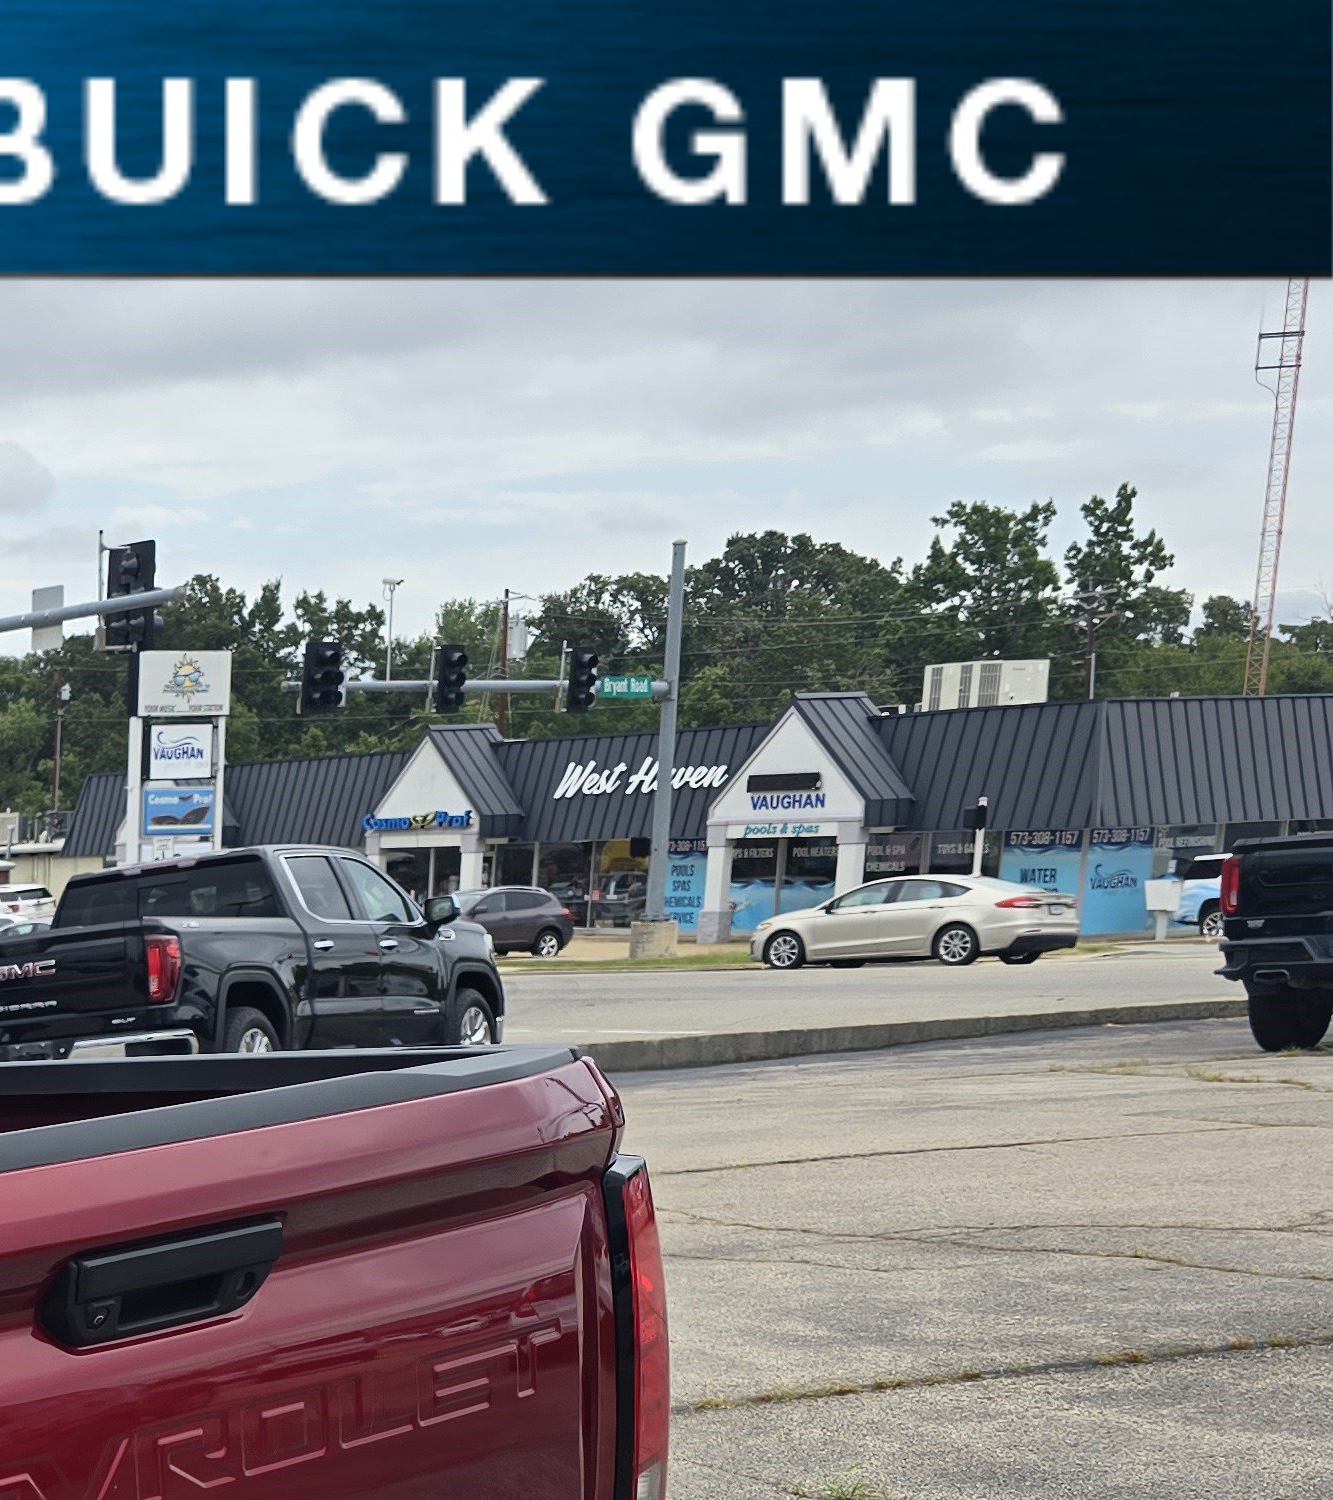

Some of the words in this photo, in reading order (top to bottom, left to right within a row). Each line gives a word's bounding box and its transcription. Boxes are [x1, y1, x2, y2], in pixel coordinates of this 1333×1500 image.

[604, 677, 628, 696] Bryant
[630, 677, 648, 693] Road
[153, 746, 204, 760] VAUGHAN
[552, 759, 628, 801] West
[625, 755, 729, 797] Hven
[148, 793, 179, 805] Cosmo
[750, 793, 826, 811] VAUGHAN
[362, 813, 410, 831] Cosmo
[435, 809, 472, 828] Prof
[743, 822, 778, 838] pools
[780, 822, 789, 834] &
[791, 824, 821, 837] spas
[1091, 828, 1151, 843] 573-308-1157
[1009, 831, 1079, 846] 573-308-1157
[792, 847, 808, 858] POOL
[671, 864, 695, 877] POOLS
[866, 861, 906, 872] CHEMICALS
[1019, 868, 1058, 884] WATER
[1089, 876, 1138, 890] VAUGHAN
[672, 879, 691, 892] SPAS
